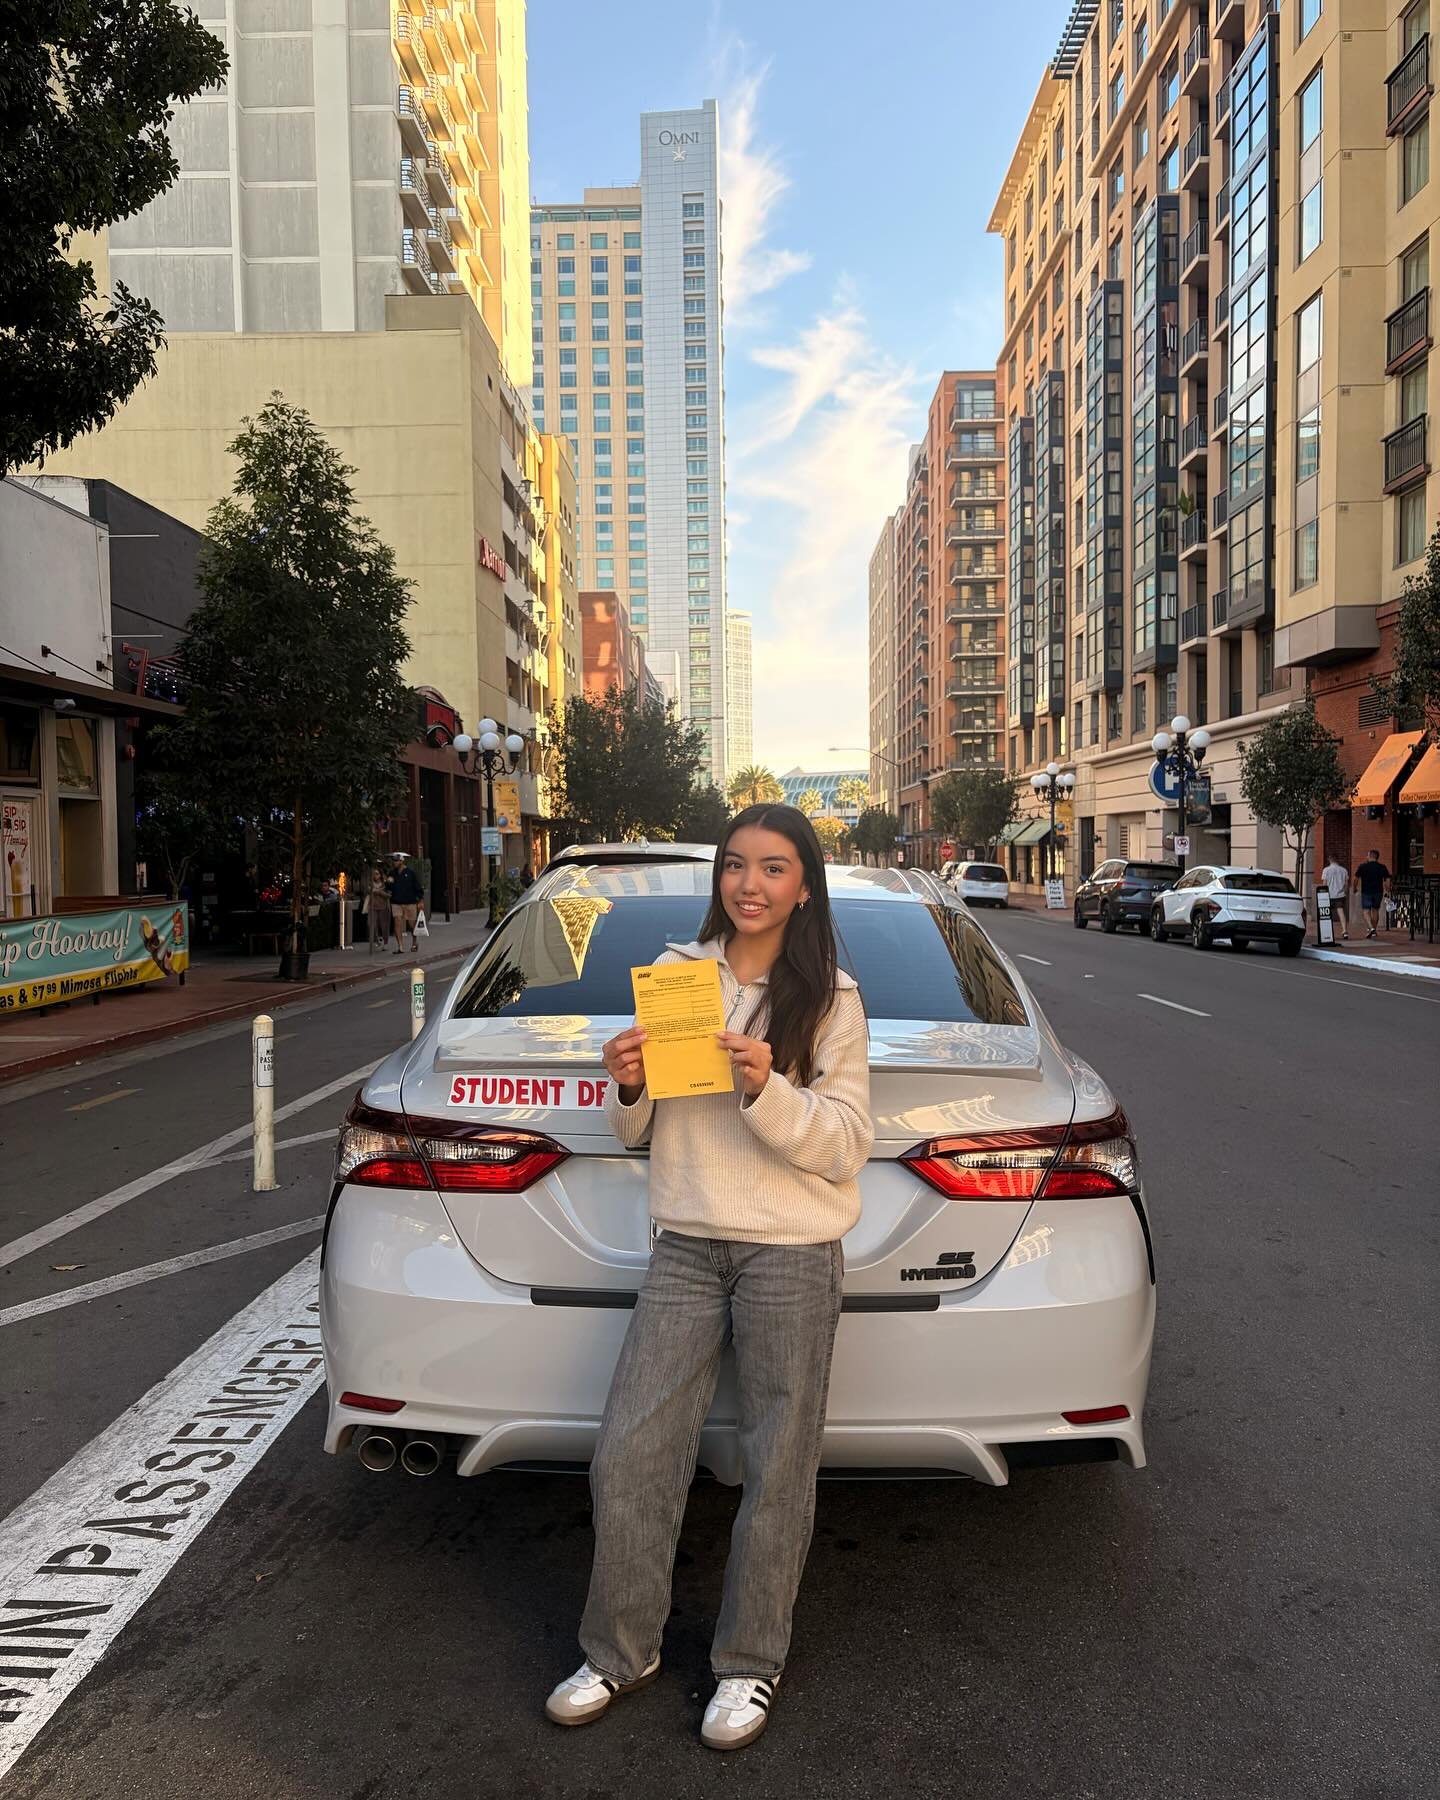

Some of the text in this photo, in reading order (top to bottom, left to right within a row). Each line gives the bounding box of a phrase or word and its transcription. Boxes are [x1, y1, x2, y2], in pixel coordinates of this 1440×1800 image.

[1319, 907, 1330, 915] NO
[26, 912, 133, 961] Hooray!
[18, 988, 28, 1004] &
[60, 975, 101, 996] Mimosa
[104, 967, 139, 986] Flights
[414, 985, 423, 995] 30
[451, 1077, 565, 1106] STUDENT
[936, 1251, 975, 1265] SE
[900, 1266, 965, 1281] HYBRID
[35, 1338, 324, 1577] PASSENGER
